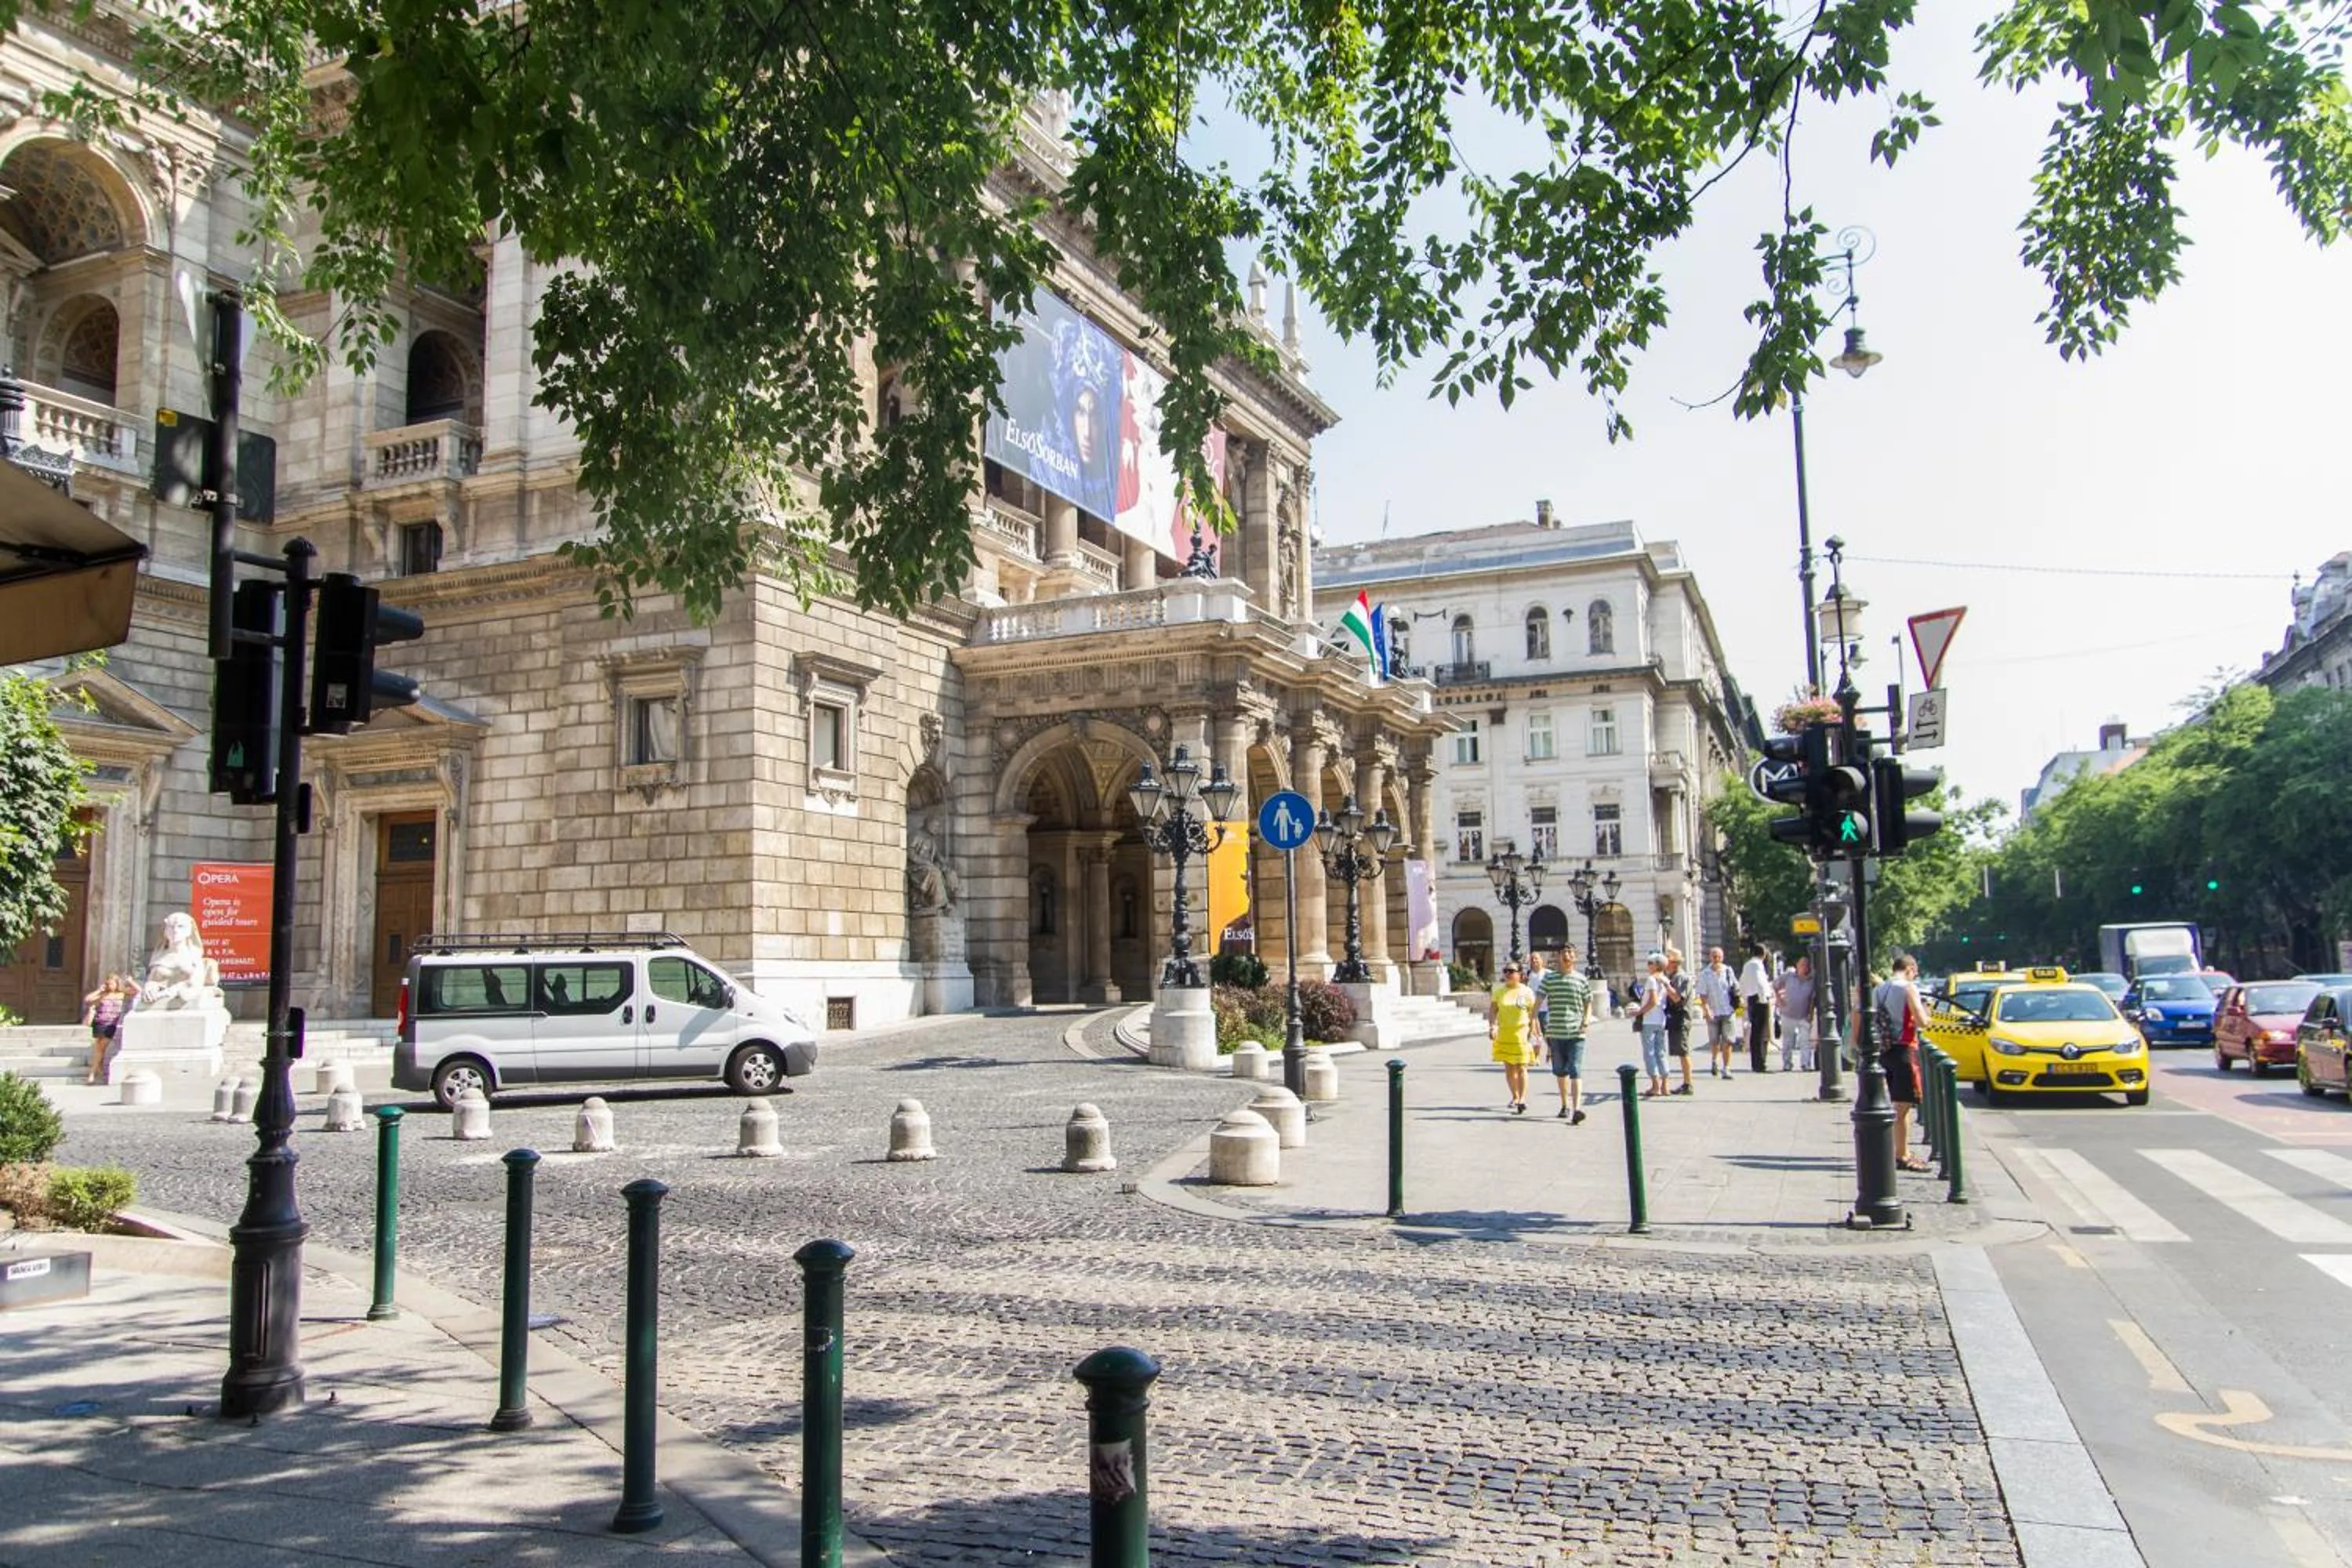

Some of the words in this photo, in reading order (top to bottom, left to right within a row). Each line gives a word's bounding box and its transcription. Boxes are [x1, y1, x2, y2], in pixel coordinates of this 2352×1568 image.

[198, 872, 239, 885] OPERA
[201, 909, 224, 918] open
[224, 906, 239, 917] for
[201, 917, 234, 928] guided
